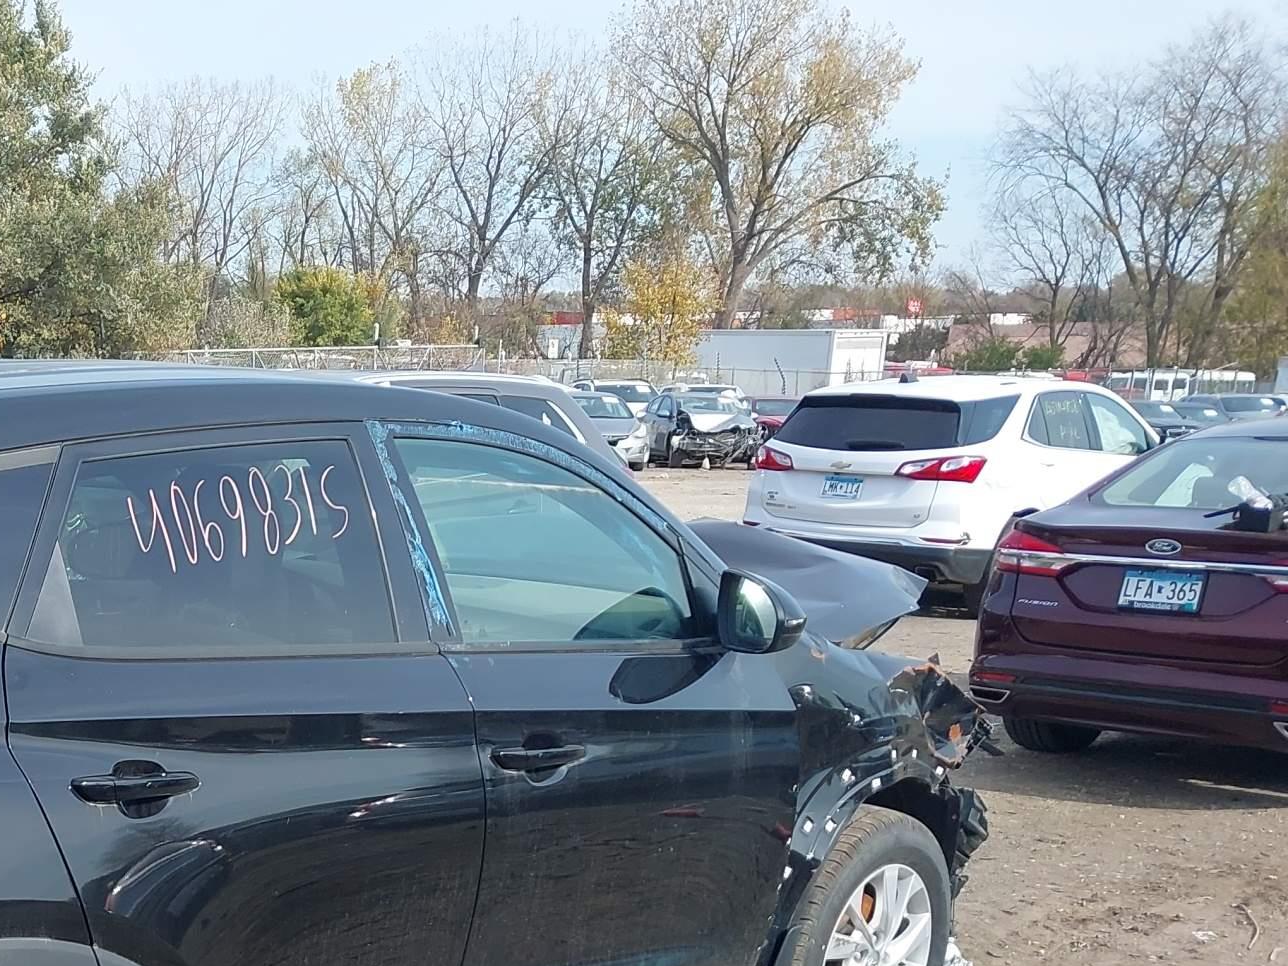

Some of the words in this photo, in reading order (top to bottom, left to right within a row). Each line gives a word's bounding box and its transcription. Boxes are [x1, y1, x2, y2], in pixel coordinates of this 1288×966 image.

[127, 465, 349, 574] 40698315
[1123, 577, 1155, 599] LFA
[1166, 581, 1199, 602] 365
